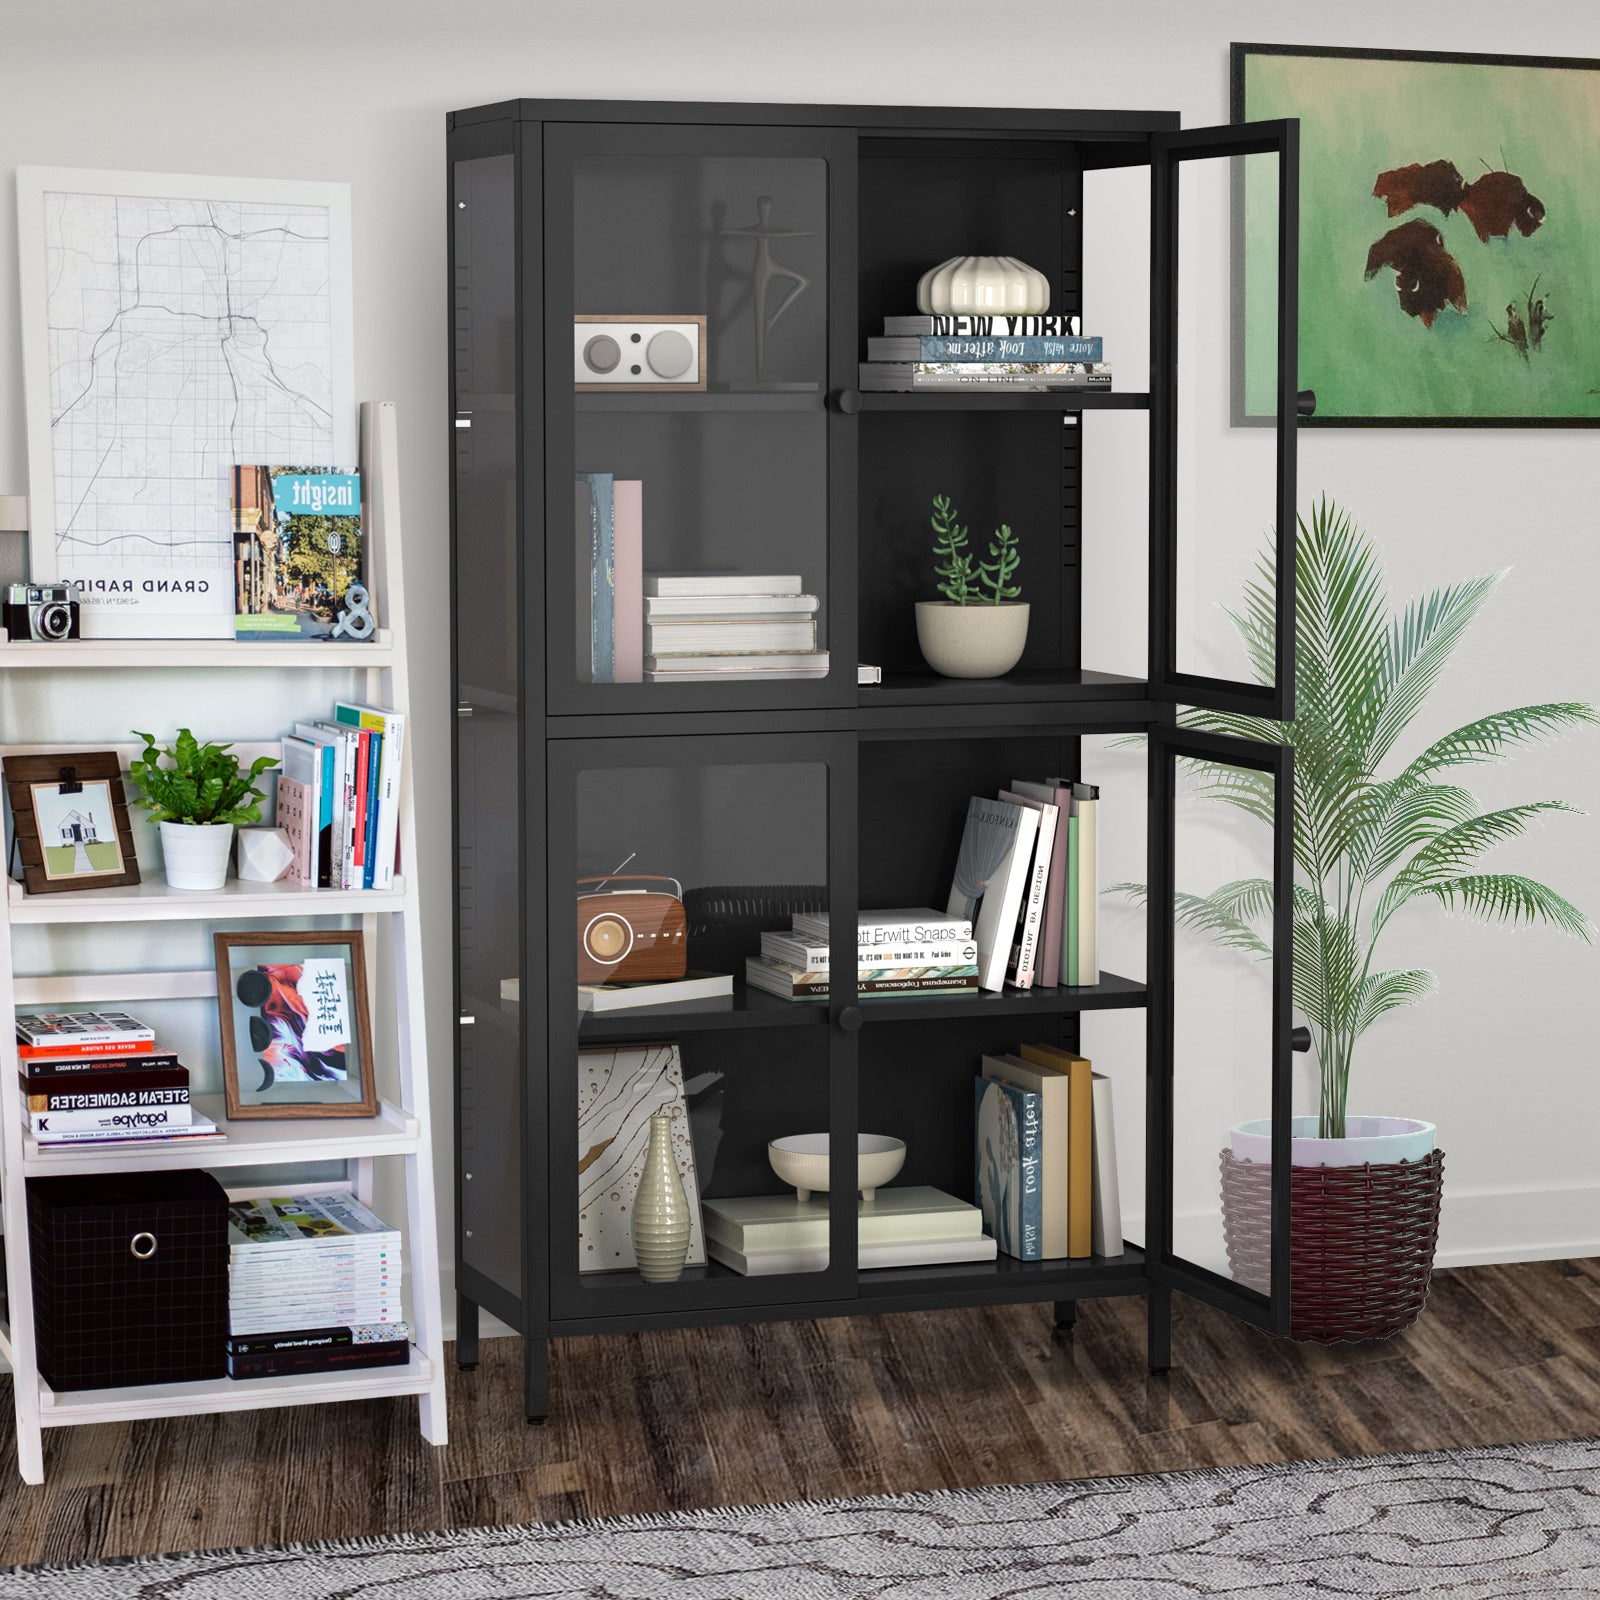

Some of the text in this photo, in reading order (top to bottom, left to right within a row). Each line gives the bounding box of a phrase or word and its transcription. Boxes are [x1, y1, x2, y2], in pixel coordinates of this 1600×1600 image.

[933, 315, 1076, 336] NEW YORK
[946, 342, 961, 355] me
[963, 341, 994, 359] after
[999, 340, 1025, 358] Look
[1043, 342, 1065, 355] Walsh
[959, 376, 981, 384] ON
[987, 376, 1020, 384] LINE
[874, 927, 911, 943] Erwitt
[914, 926, 956, 941] Snaps
